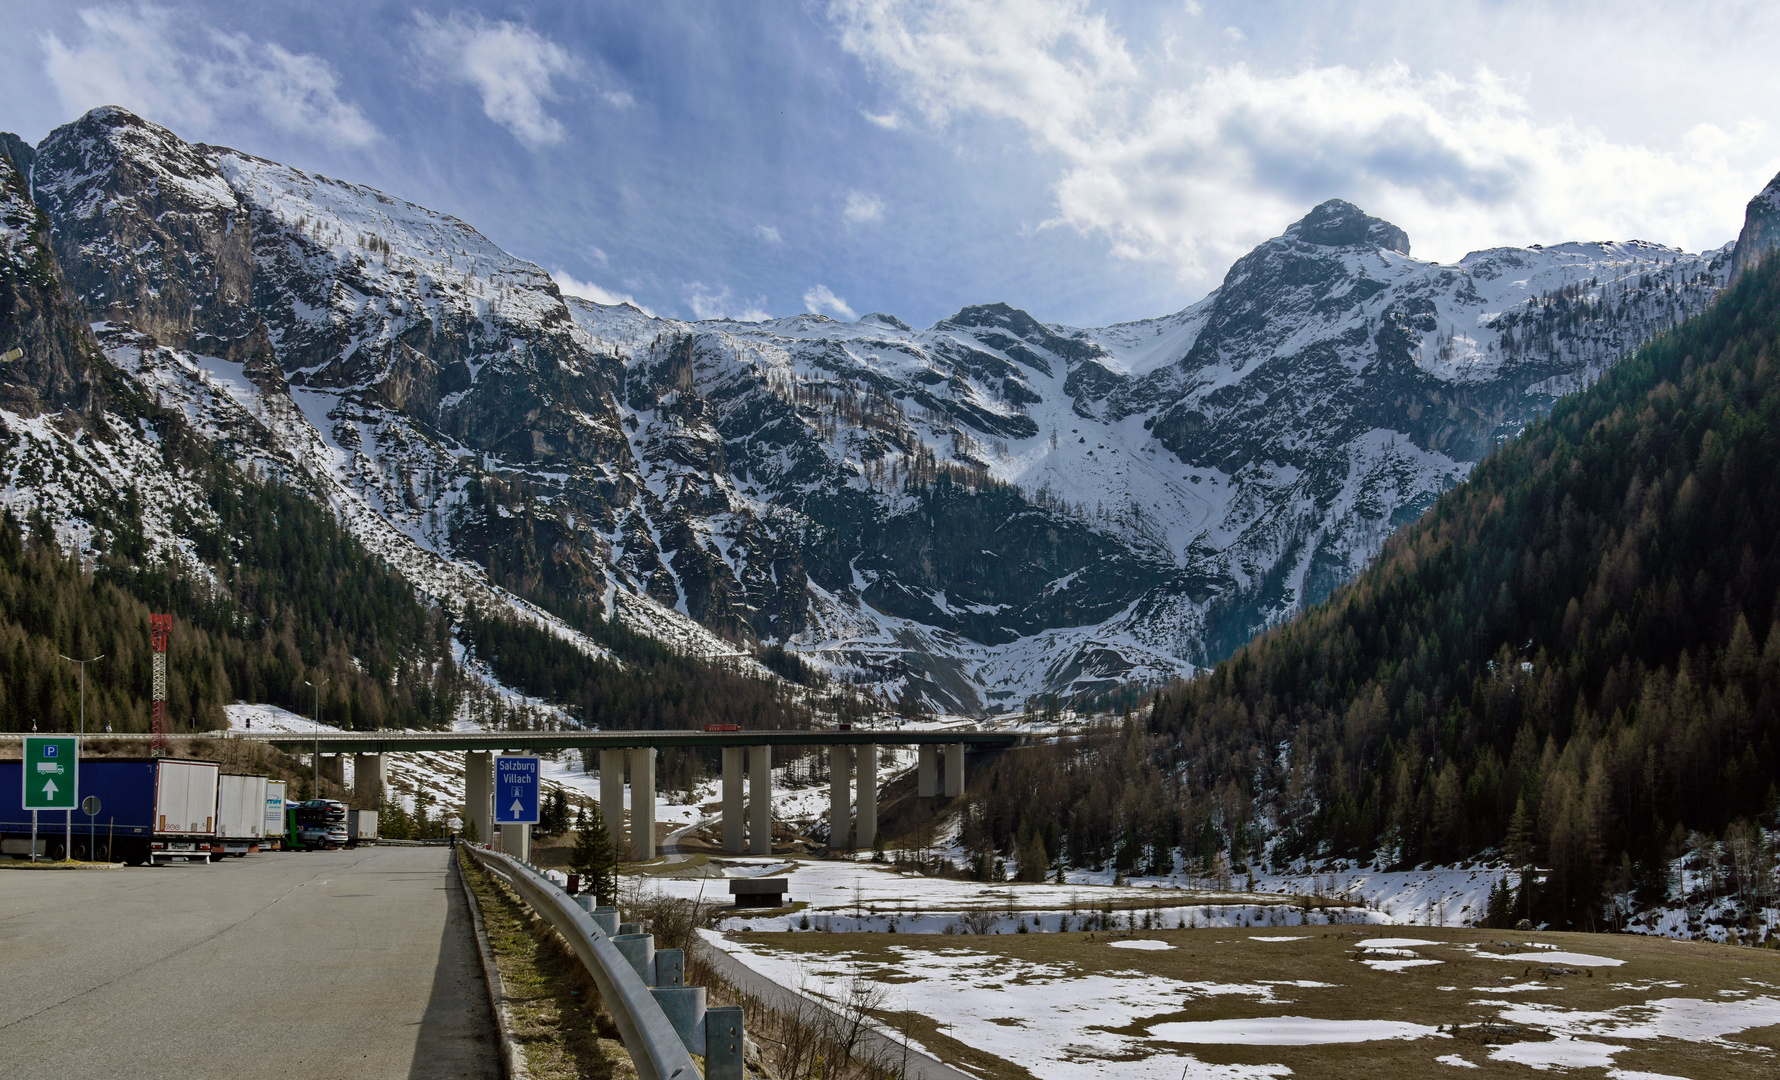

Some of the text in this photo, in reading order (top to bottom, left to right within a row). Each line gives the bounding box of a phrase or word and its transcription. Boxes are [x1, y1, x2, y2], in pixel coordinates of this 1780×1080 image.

[48, 747, 55, 755] P
[499, 761, 535, 772] Salzburg
[504, 774, 532, 783] Villach
